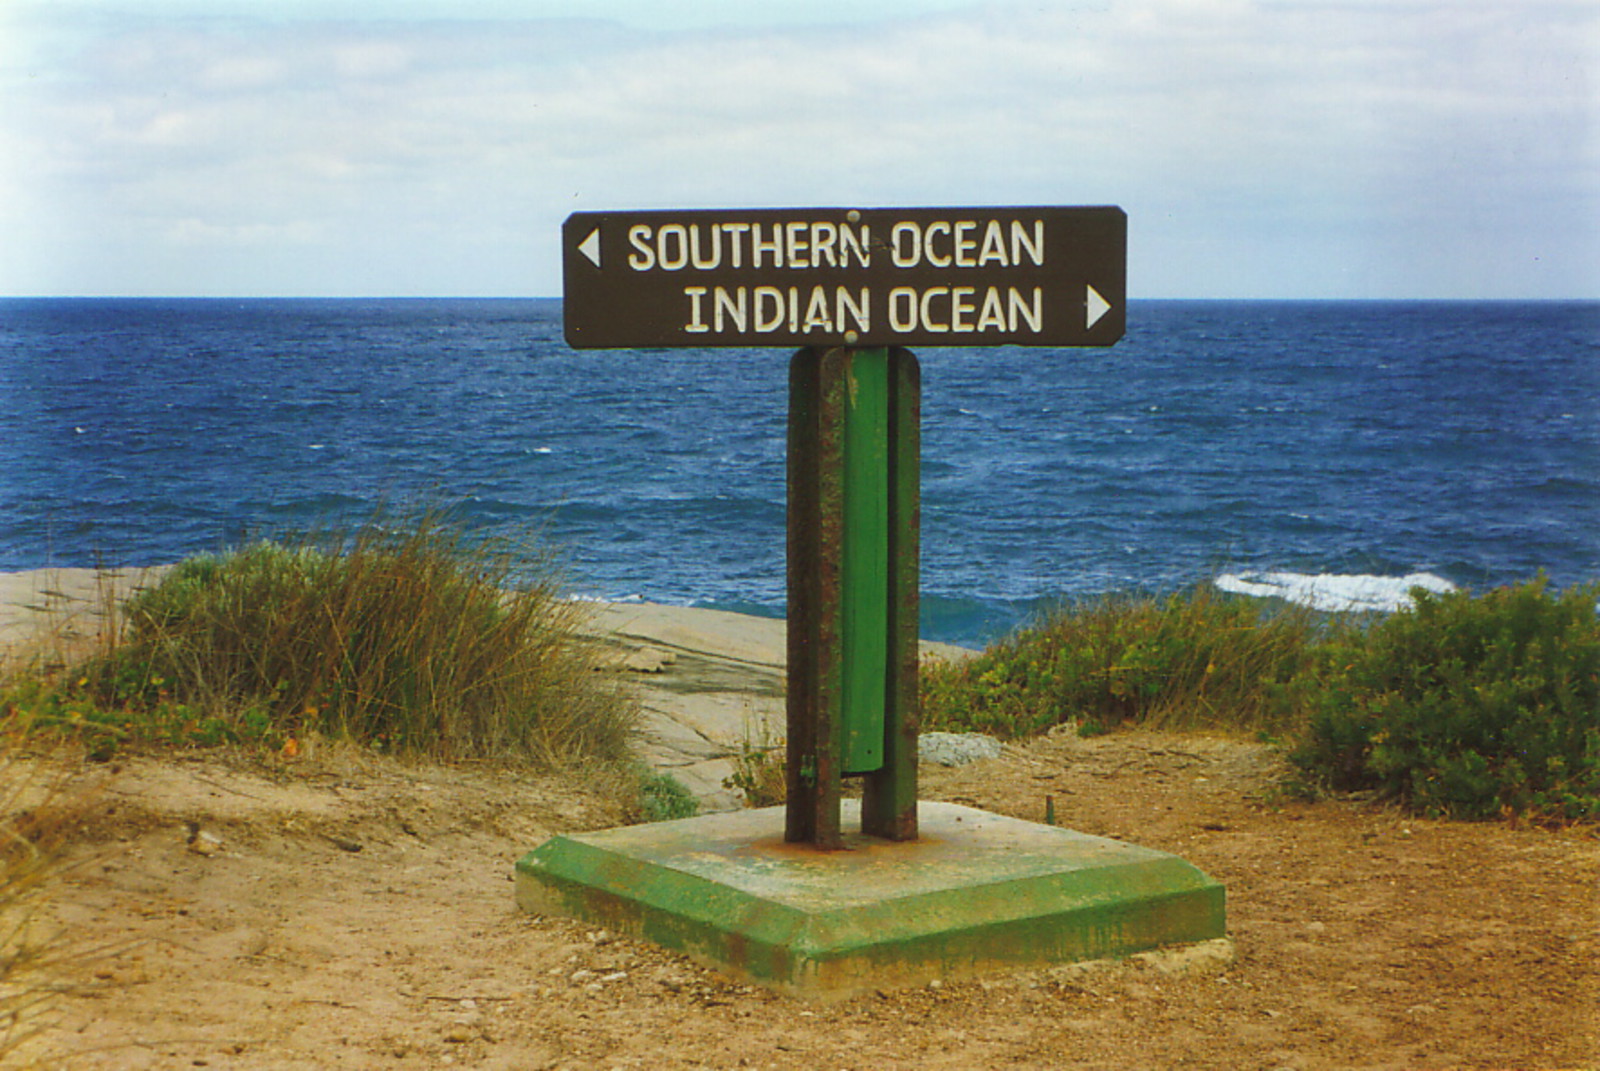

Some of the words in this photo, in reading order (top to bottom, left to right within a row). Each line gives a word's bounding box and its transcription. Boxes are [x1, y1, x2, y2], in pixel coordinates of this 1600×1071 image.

[627, 223, 870, 271] SOUTHERN
[891, 221, 1044, 267] OCEAN
[684, 287, 870, 333] INDIAN
[888, 288, 1042, 333] OCEAN
